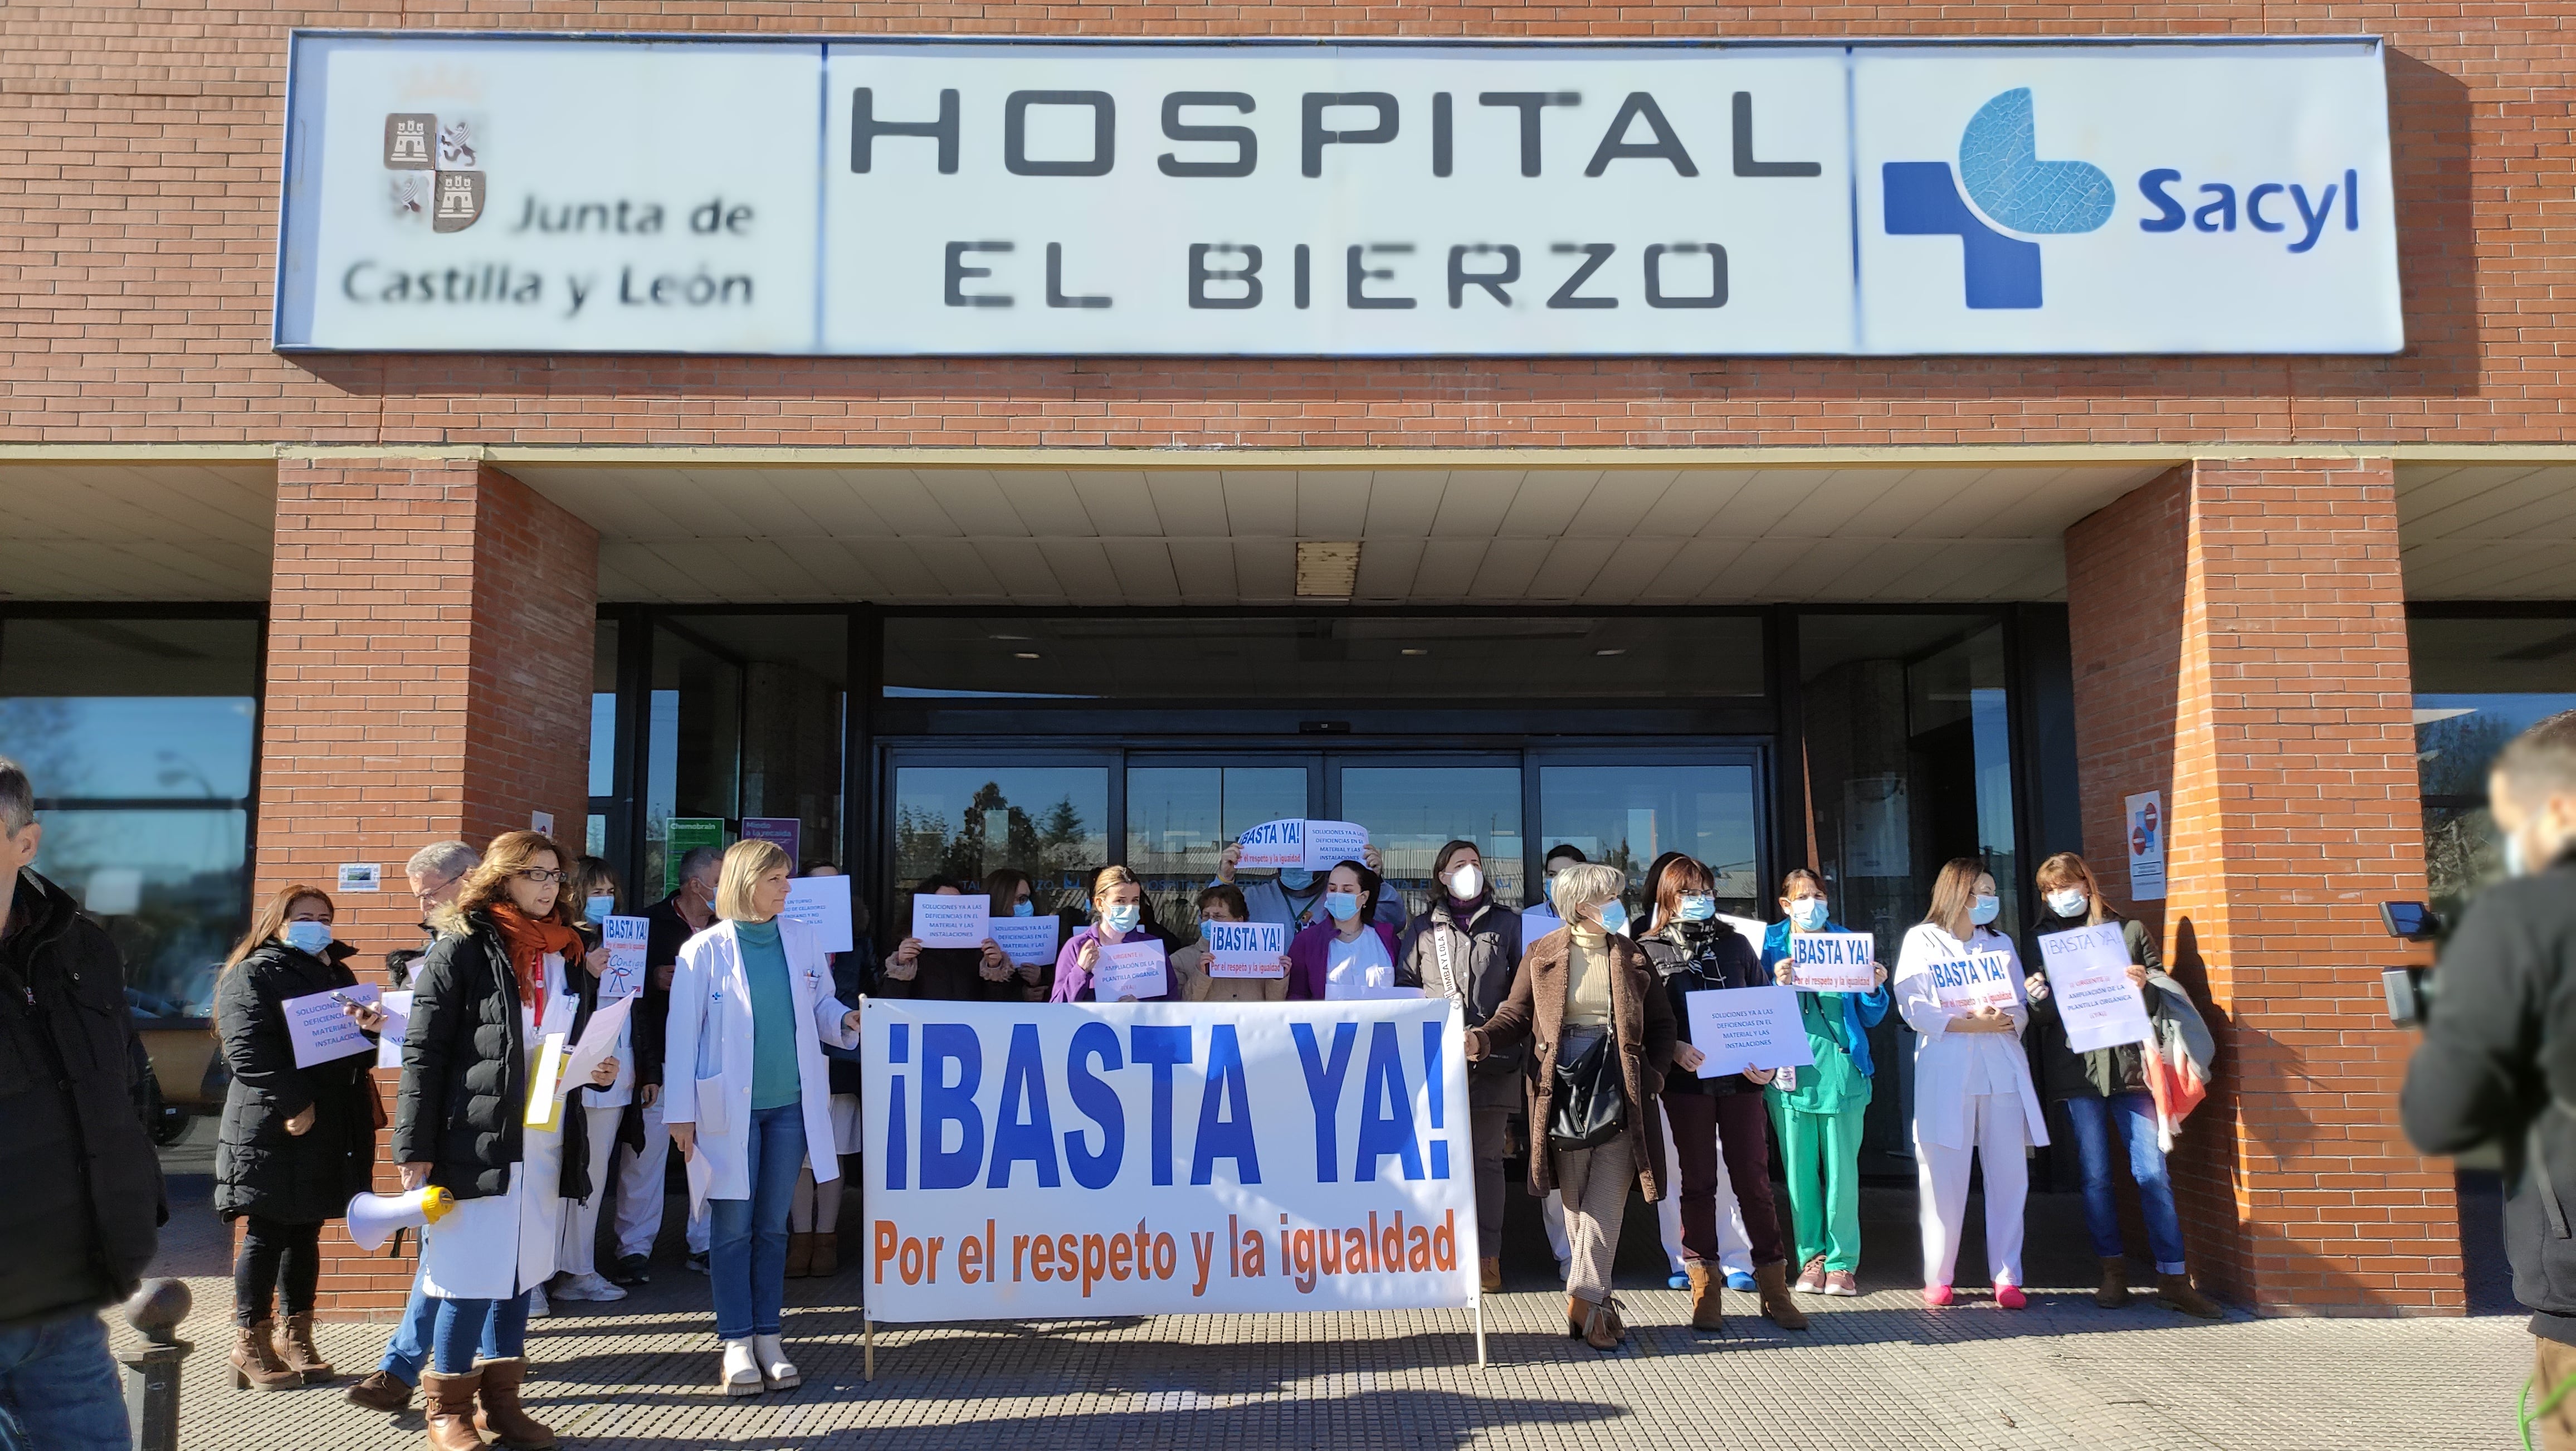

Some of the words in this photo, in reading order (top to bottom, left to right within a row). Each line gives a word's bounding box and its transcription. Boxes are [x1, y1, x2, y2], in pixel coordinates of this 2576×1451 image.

[851, 87, 1822, 178] HOSPITAL
[514, 193, 663, 235] Junta
[689, 197, 755, 235] de
[2139, 168, 2359, 253] Sacyl
[945, 242, 1113, 308] EL
[1188, 242, 1729, 309] BIERZO
[342, 260, 541, 305] Castilla
[567, 274, 597, 317] y
[620, 261, 752, 305] León
[1281, 822, 1300, 844] YA!
[1249, 854, 1268, 864] respeto
[1279, 853, 1300, 864] igualdad
[606, 919, 633, 939] ¡BASTA
[636, 921, 647, 940] YA!
[1212, 927, 1257, 951] ¡BASTA
[1261, 928, 1280, 951] YA!
[1794, 939, 1843, 964] ¡BASTA
[1846, 939, 1869, 965] YA!
[2043, 934, 2095, 955] ¡BASTA
[2096, 928, 2120, 946] YA!
[1102, 974, 1131, 982] PLANTILLA
[1211, 962, 1219, 971] Por
[1227, 962, 1247, 974] respeto
[1259, 962, 1280, 974] igualdad
[1929, 960, 1981, 988] ¡BASTA
[1978, 955, 2006, 981] YA!
[1794, 976, 1803, 985] Por
[1812, 976, 1833, 987] respeto
[1846, 975, 1870, 989] igualdad
[296, 1002, 340, 1016] SOLUCIONES
[304, 1013, 345, 1026] DEFICIENCI
[312, 1024, 347, 1036] MATERIAL
[1716, 1020, 1755, 1029] DEFICIENCIAS
[315, 1033, 359, 1048] INSTALACION
[1725, 1039, 1772, 1049] INSTALACIONES
[886, 1022, 1261, 1190] ¡BASTA
[1290, 1021, 1450, 1182] YA!
[875, 1220, 944, 1286] Por
[958, 1219, 996, 1286] el
[1013, 1217, 1177, 1298] respeto
[1191, 1231, 1214, 1297] y
[1229, 1214, 1266, 1278] la
[1280, 1209, 1457, 1294] igualdad
